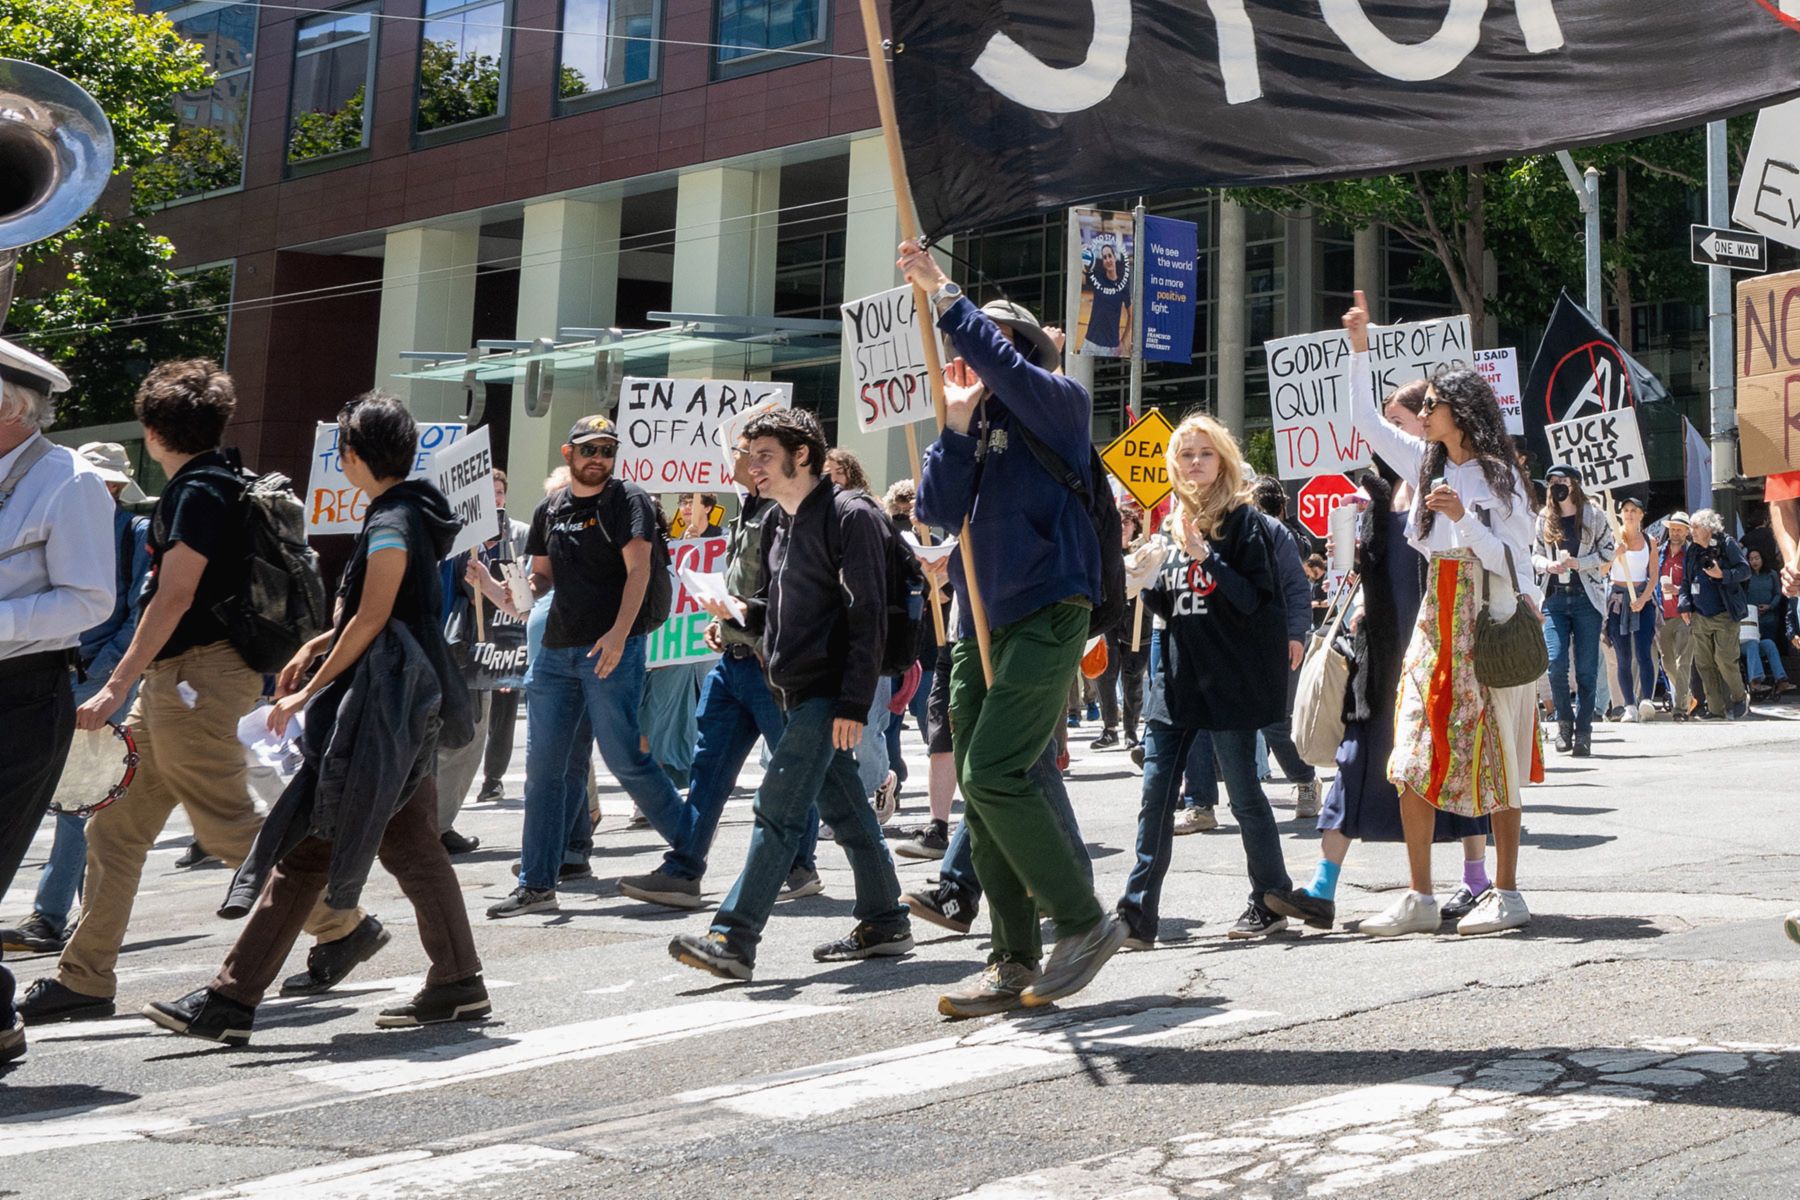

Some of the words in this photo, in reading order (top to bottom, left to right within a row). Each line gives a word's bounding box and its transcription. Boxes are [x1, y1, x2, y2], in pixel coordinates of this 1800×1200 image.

[1150, 243, 1165, 255] We
[1165, 249, 1180, 258] see
[1714, 241, 1734, 254] ONE
[1737, 243, 1757, 257] WAY
[1157, 257, 1171, 268] the
[1171, 260, 1193, 271] world
[1150, 274, 1158, 286] in
[1158, 277, 1164, 286] a
[1165, 279, 1184, 289] more
[1156, 290, 1187, 303] positive
[846, 301, 892, 343] YOU
[856, 332, 925, 381] STILL
[1271, 330, 1407, 377] GODFAHER
[1410, 324, 1438, 356] OF
[1441, 320, 1466, 350] AI
[1483, 350, 1509, 361] SAID
[629, 381, 675, 411] IN
[685, 384, 708, 417] A
[861, 373, 917, 425] STOP
[1275, 374, 1343, 420] QUIT
[629, 419, 689, 448] OFF
[1551, 416, 1619, 450] FUCK
[1124, 440, 1168, 458] DEA
[1277, 426, 1320, 470] TO
[1558, 439, 1618, 466] THIS
[439, 473, 450, 497] AI
[451, 448, 490, 494] FREEZE
[622, 457, 654, 483] NO
[661, 459, 713, 484] ONE
[1130, 465, 1169, 483] END
[1578, 453, 1634, 487] HIT
[1302, 493, 1341, 519] STO
[474, 642, 529, 670] TORME
